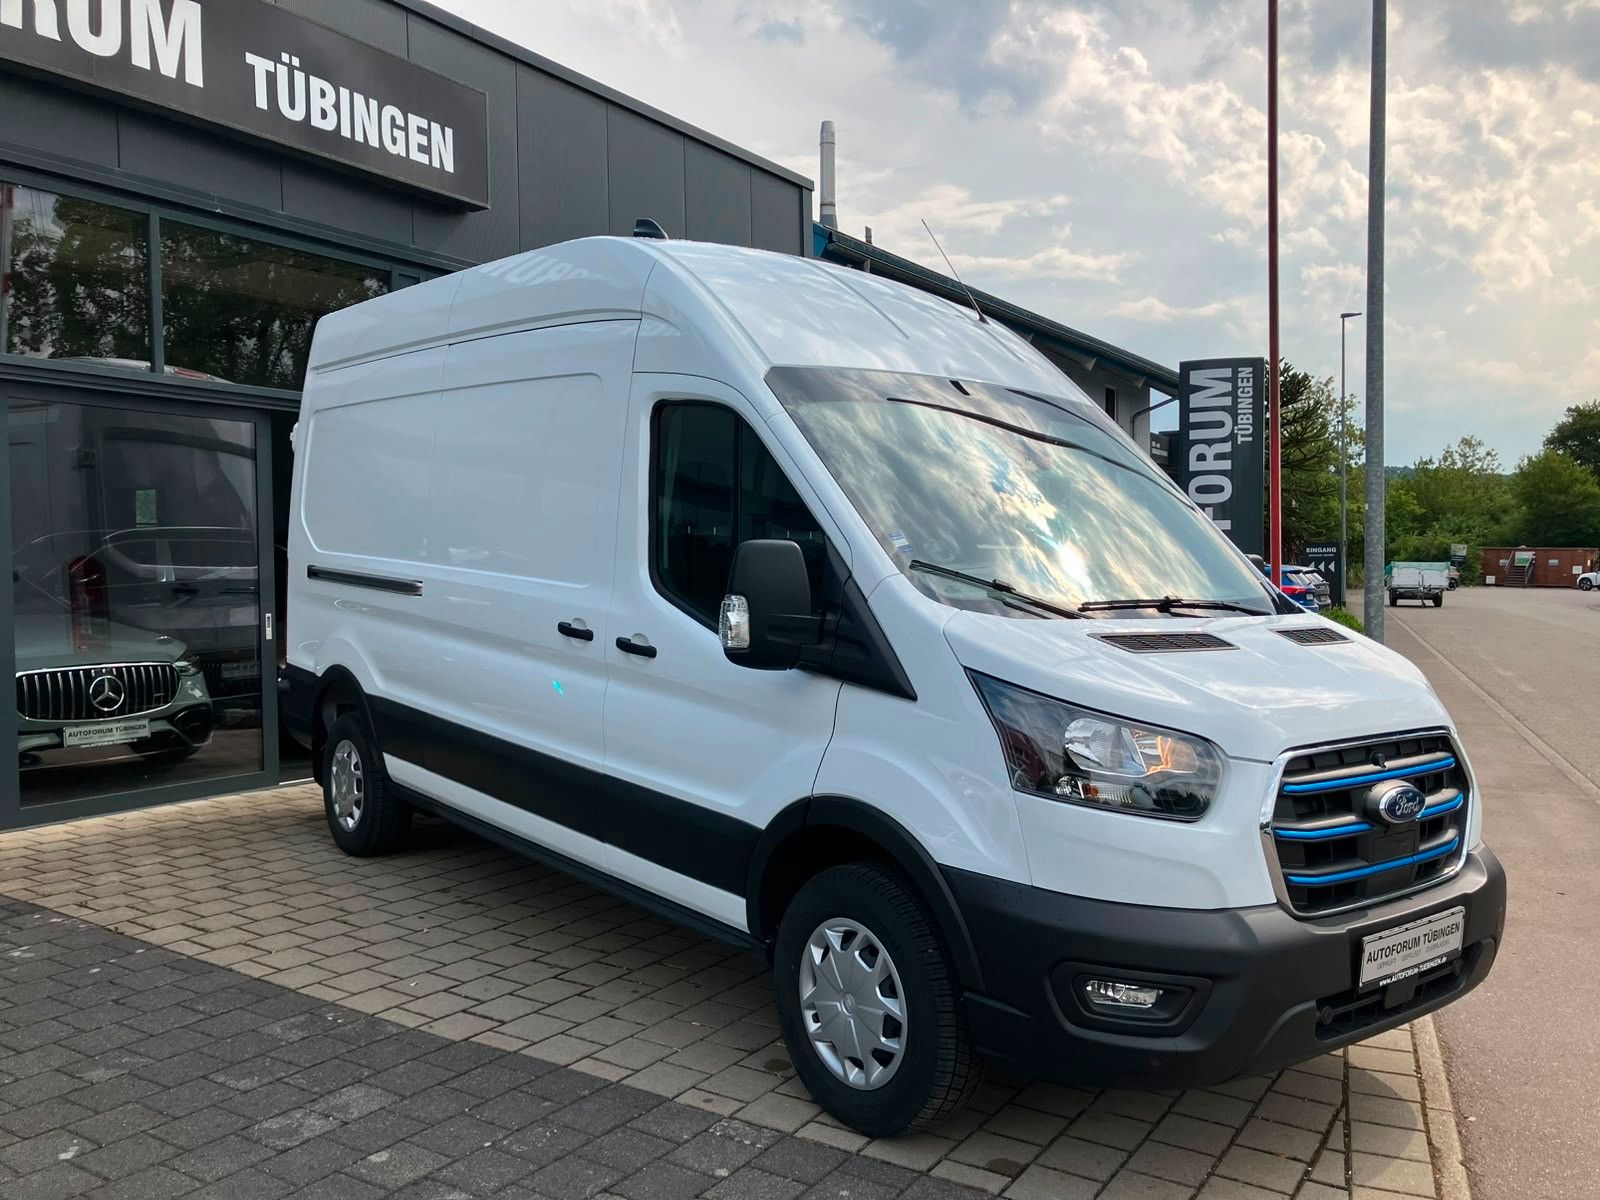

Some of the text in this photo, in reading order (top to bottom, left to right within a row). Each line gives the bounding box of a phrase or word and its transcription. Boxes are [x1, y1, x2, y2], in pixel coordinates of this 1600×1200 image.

[245, 52, 454, 173] TÜBINGEN
[1234, 367, 1253, 444] TÜBINGEN
[68, 727, 113, 738] AUTOFORUM
[1396, 793, 1420, 815] Ford
[1367, 936, 1420, 964] AUTOFORUM
[1423, 922, 1460, 944] TÜBINGEN
